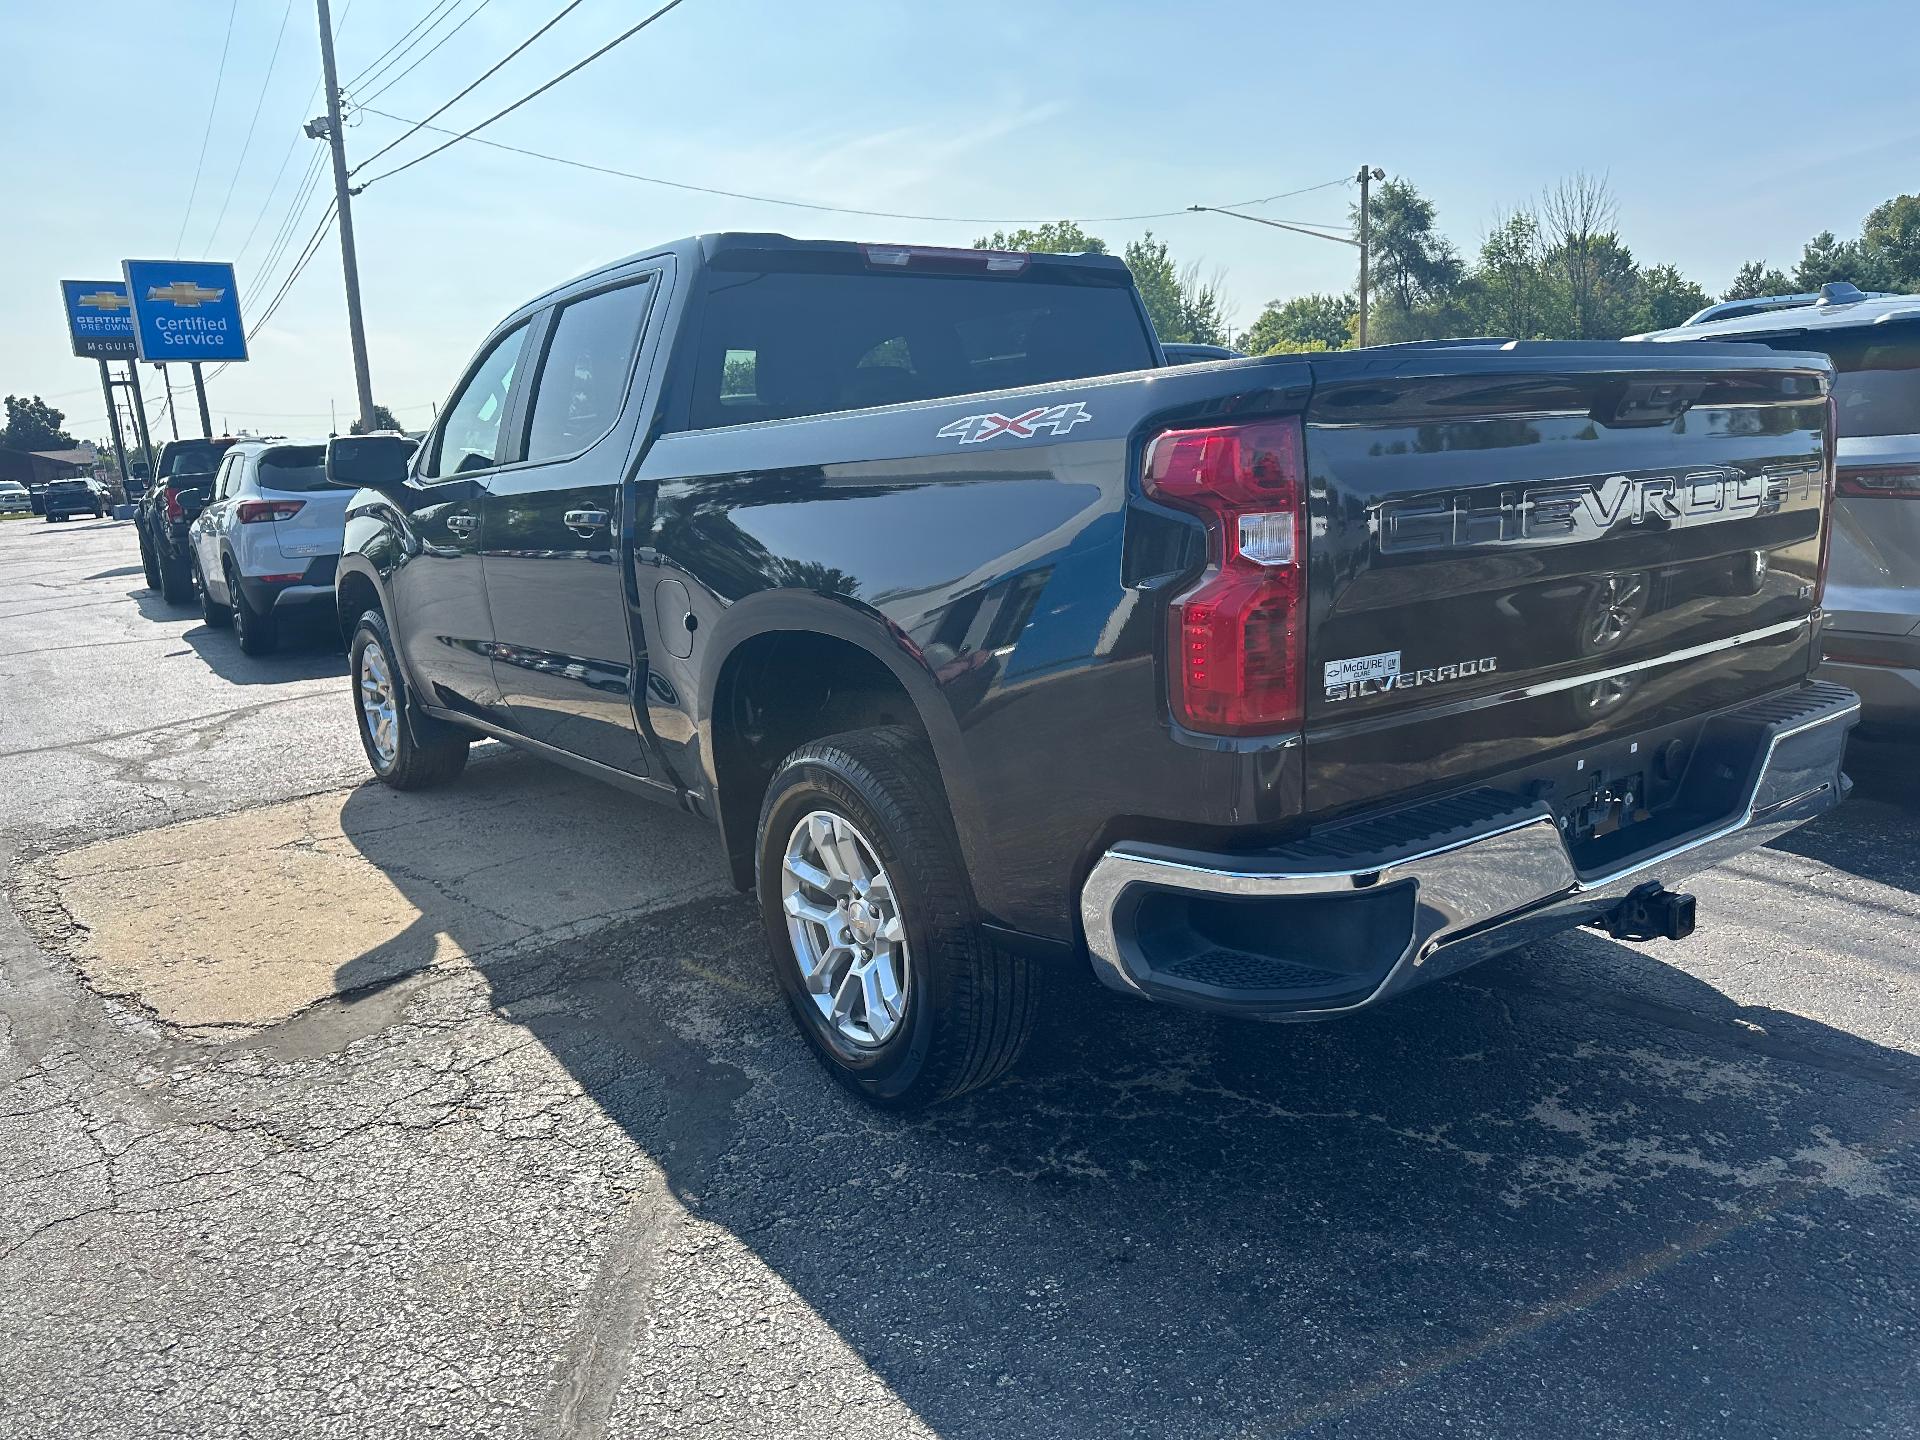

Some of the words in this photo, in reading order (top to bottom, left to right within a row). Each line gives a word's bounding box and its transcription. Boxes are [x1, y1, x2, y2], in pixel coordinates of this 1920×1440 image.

[77, 316, 132, 324] CERTIFIE
[155, 317, 227, 331] Certified
[164, 332, 224, 345] Service
[87, 342, 135, 351] McGUIR
[1379, 461, 1820, 554] CHEVROLET
[1343, 658, 1383, 674] McGUIRE
[1325, 656, 1497, 702] SILVERADO
[1353, 669, 1371, 679] CLARE
